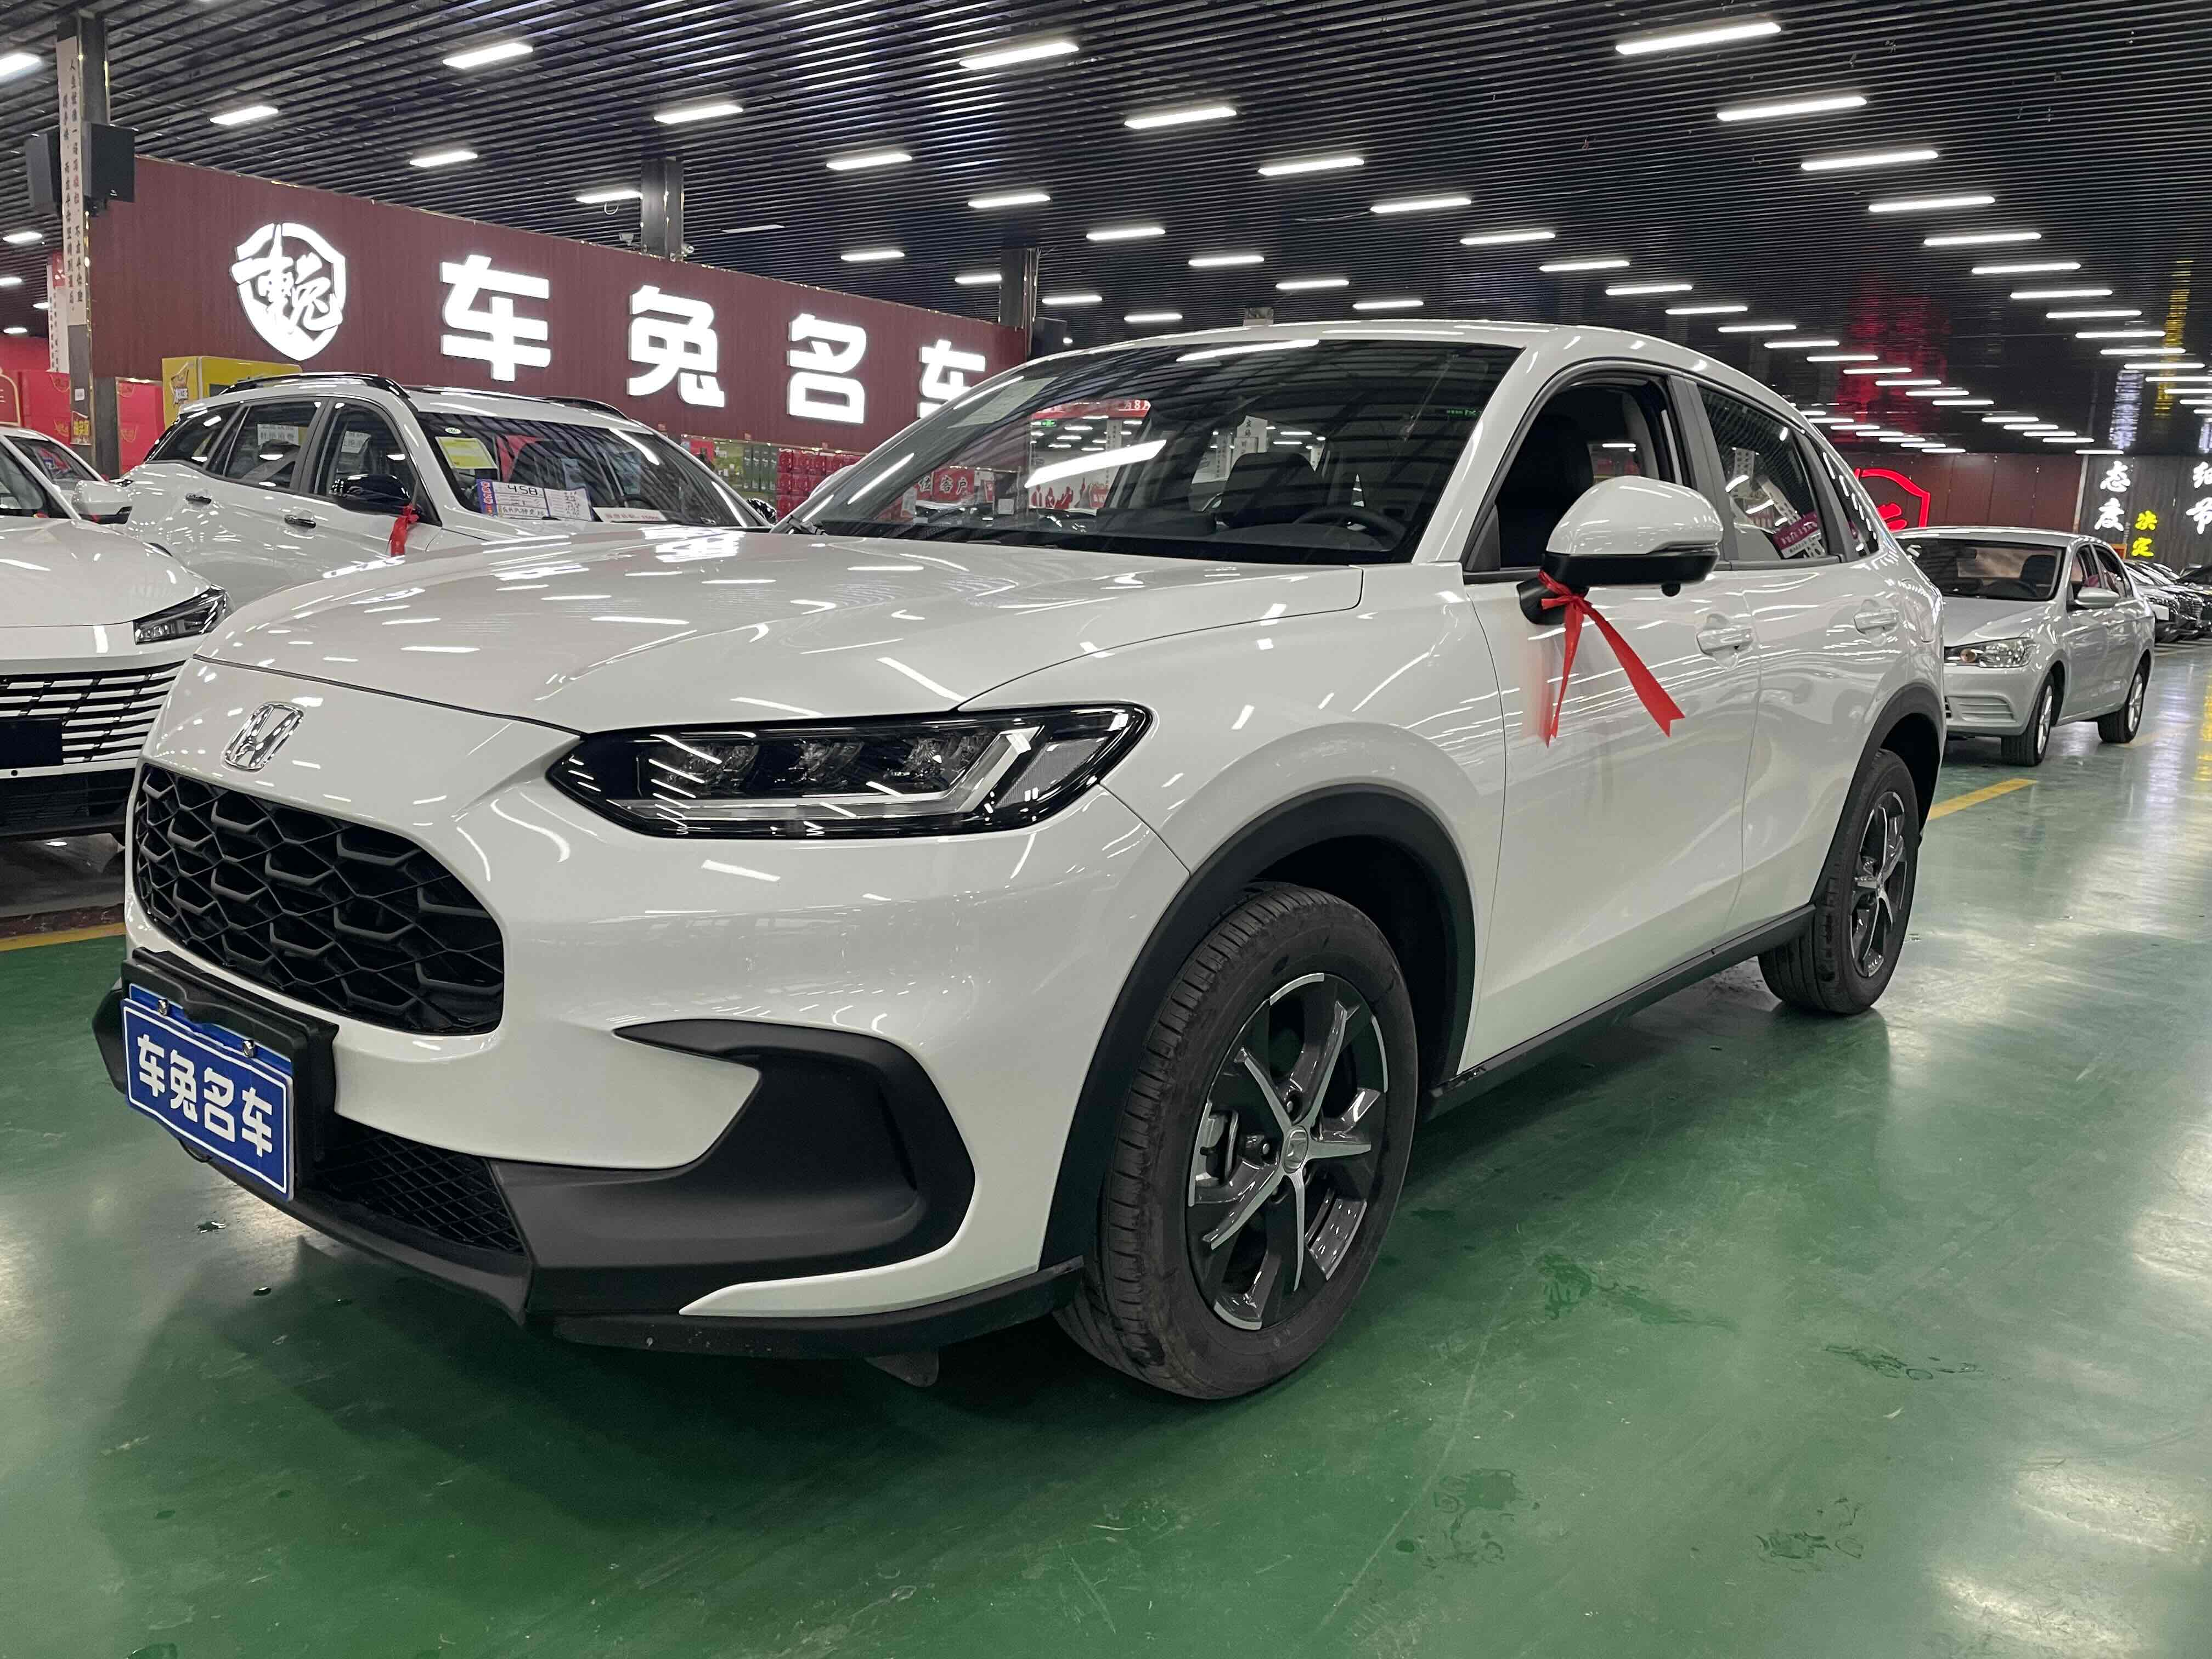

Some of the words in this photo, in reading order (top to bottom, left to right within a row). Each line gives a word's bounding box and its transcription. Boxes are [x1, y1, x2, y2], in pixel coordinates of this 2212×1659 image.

[440, 253, 987, 424] 车兔名车
[2094, 460, 2131, 532] 态度
[2131, 510, 2159, 557] 决定
[137, 1034, 274, 1158] 车兔名车
